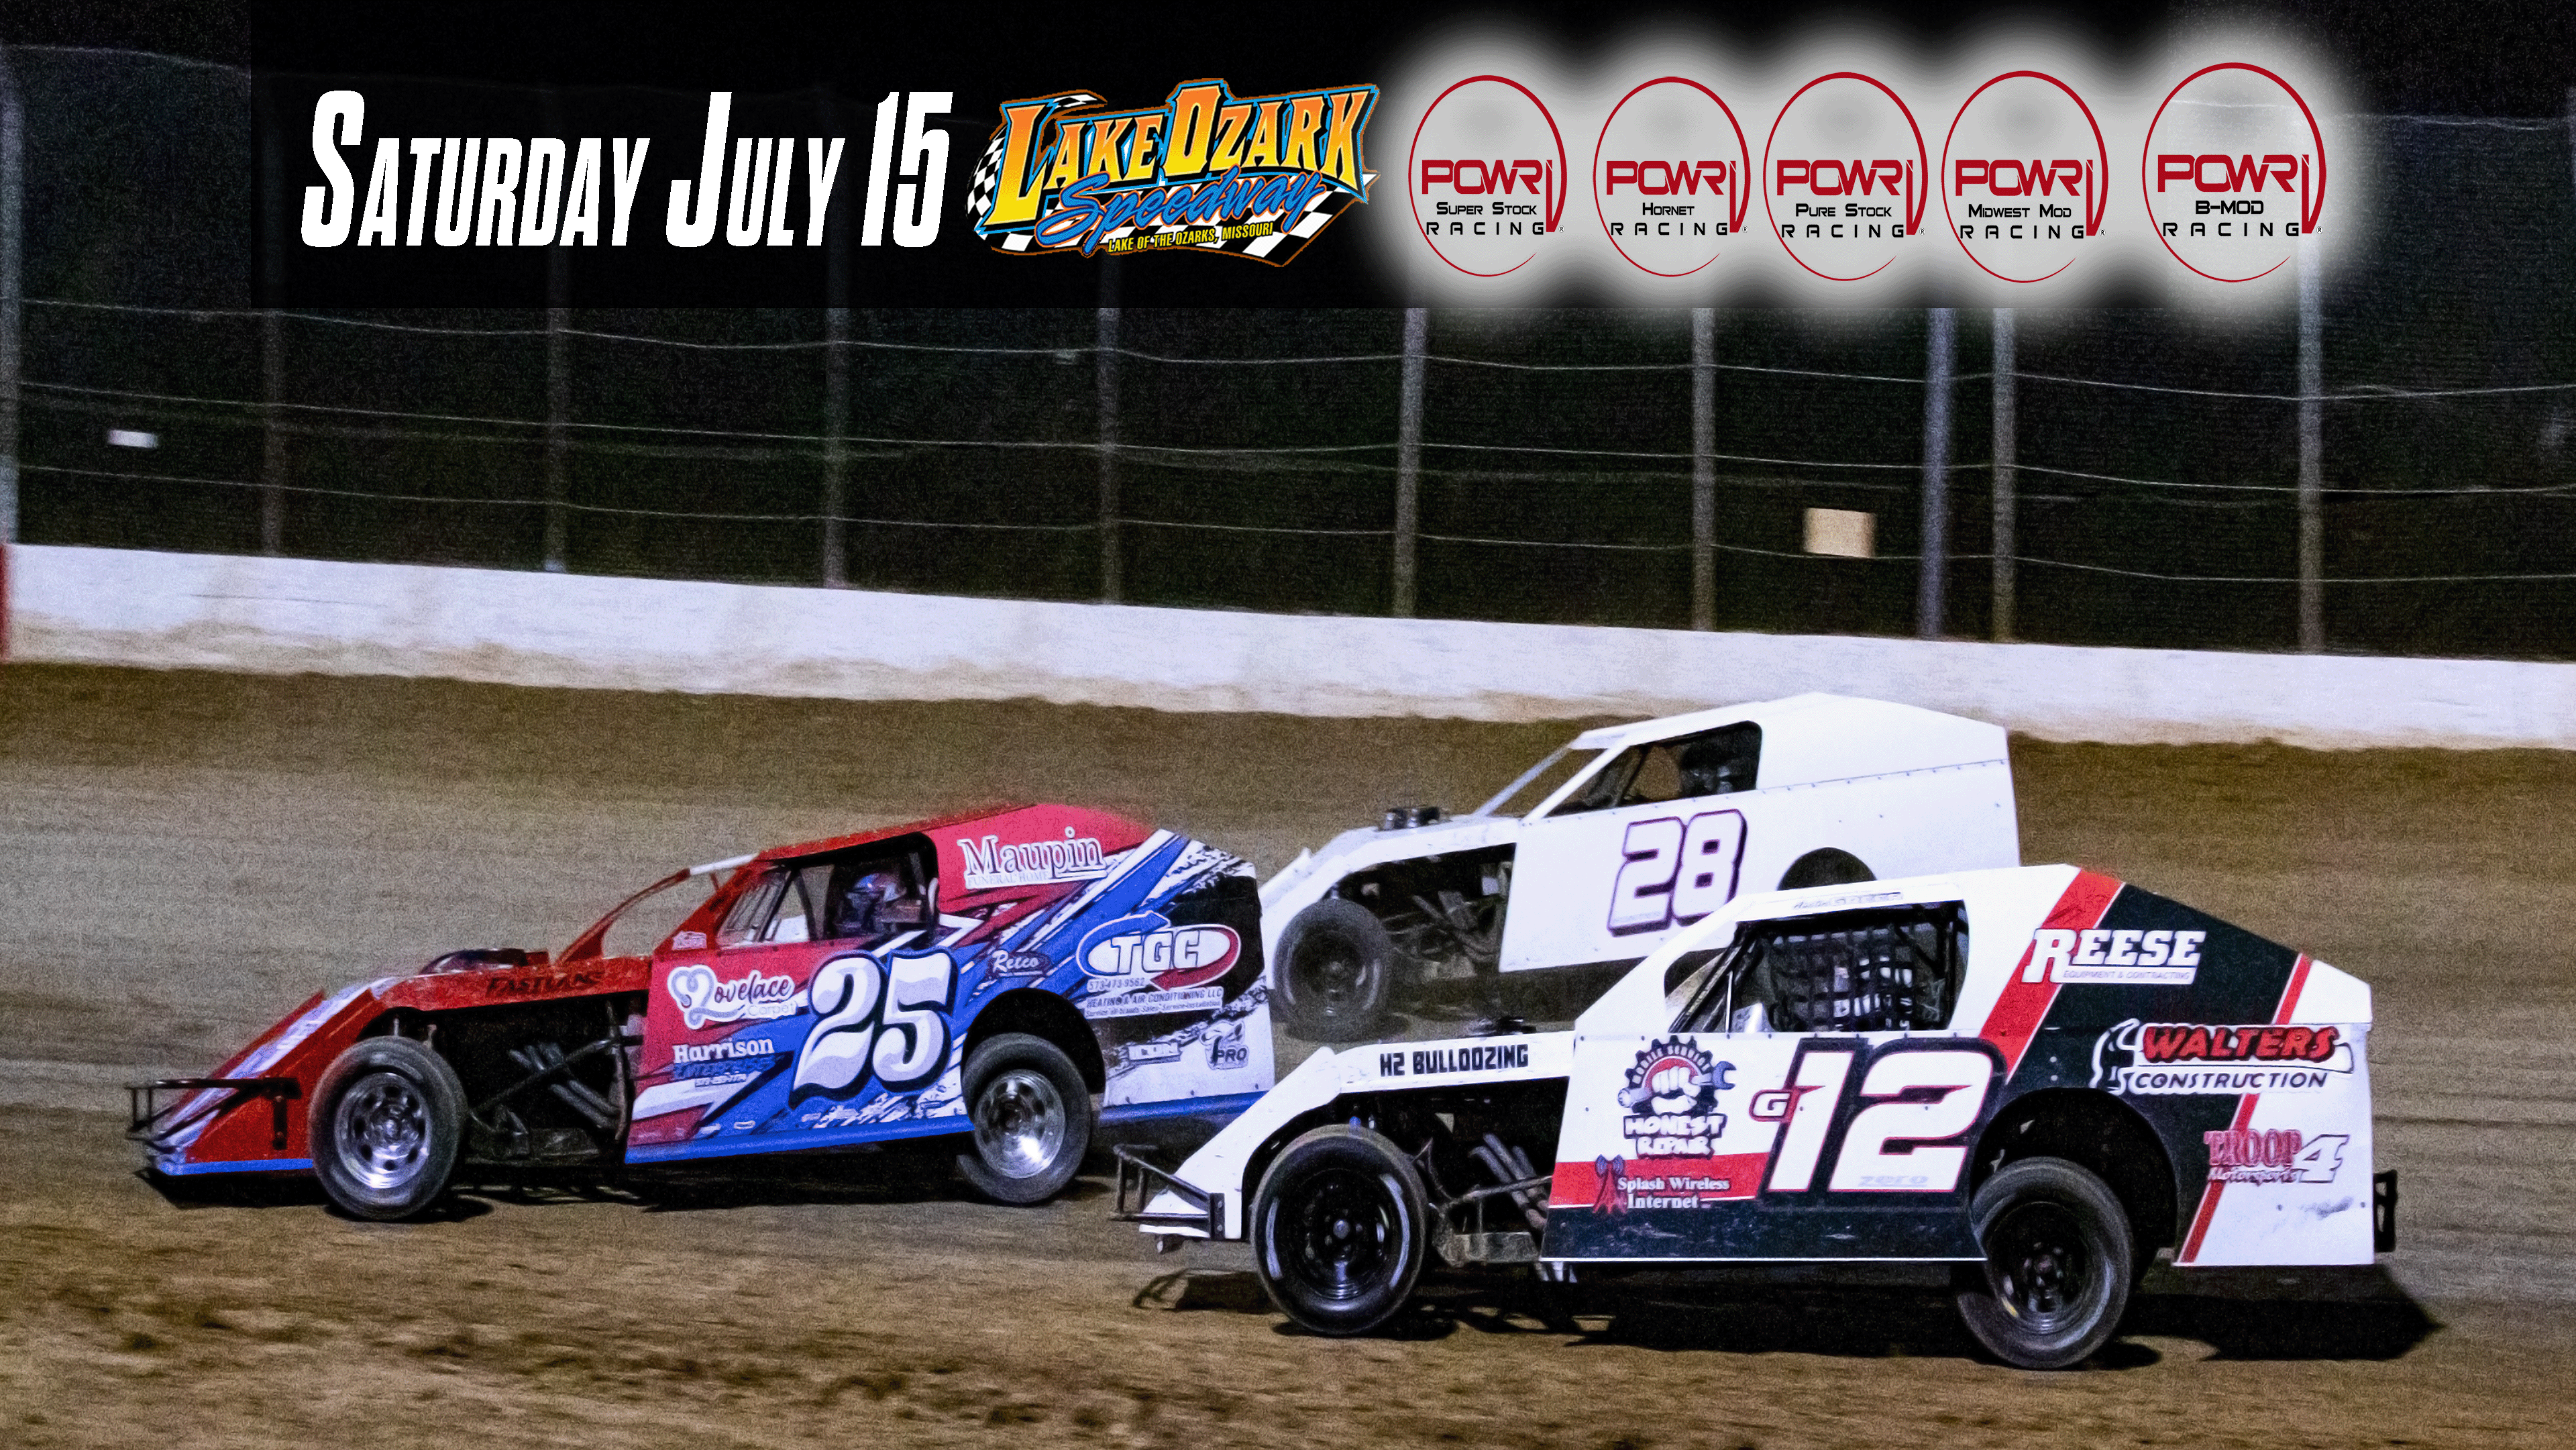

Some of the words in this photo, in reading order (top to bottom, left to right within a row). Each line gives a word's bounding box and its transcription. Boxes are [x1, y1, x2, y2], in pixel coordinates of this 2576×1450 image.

[957, 826, 1106, 880] Maupin
[967, 874, 1016, 886] FUNERAL
[1018, 871, 1050, 884] HOME
[1608, 809, 1746, 936] 28
[1111, 929, 1201, 974] TGC
[2022, 929, 2206, 982] REESE
[2063, 970, 2115, 978] EQUIPMENT
[2126, 971, 2190, 980] CONTRACTING
[1132, 993, 1146, 1004] AIR
[1148, 988, 1205, 1004] CONDITIONING
[1208, 987, 1222, 998] LLC
[791, 947, 958, 1108] 25
[673, 1038, 775, 1064] Harrison
[2142, 1025, 2339, 1064] WALTERS
[1380, 1052, 1405, 1078] H2
[1412, 1044, 1529, 1075] BULLDOZING
[2135, 1071, 2330, 1090] CONSTRUCTION
[1625, 1116, 1725, 1136] HONEST
[1756, 1038, 2008, 1194] 12
[1638, 1136, 1712, 1156] REPAIR
[2203, 1129, 2303, 1168] TROOP
[2297, 1133, 2351, 1184] 4
[1617, 1176, 1666, 1193] Splash
[1668, 1176, 1731, 1190] Wireless
[1627, 1192, 1699, 1208] Internet
